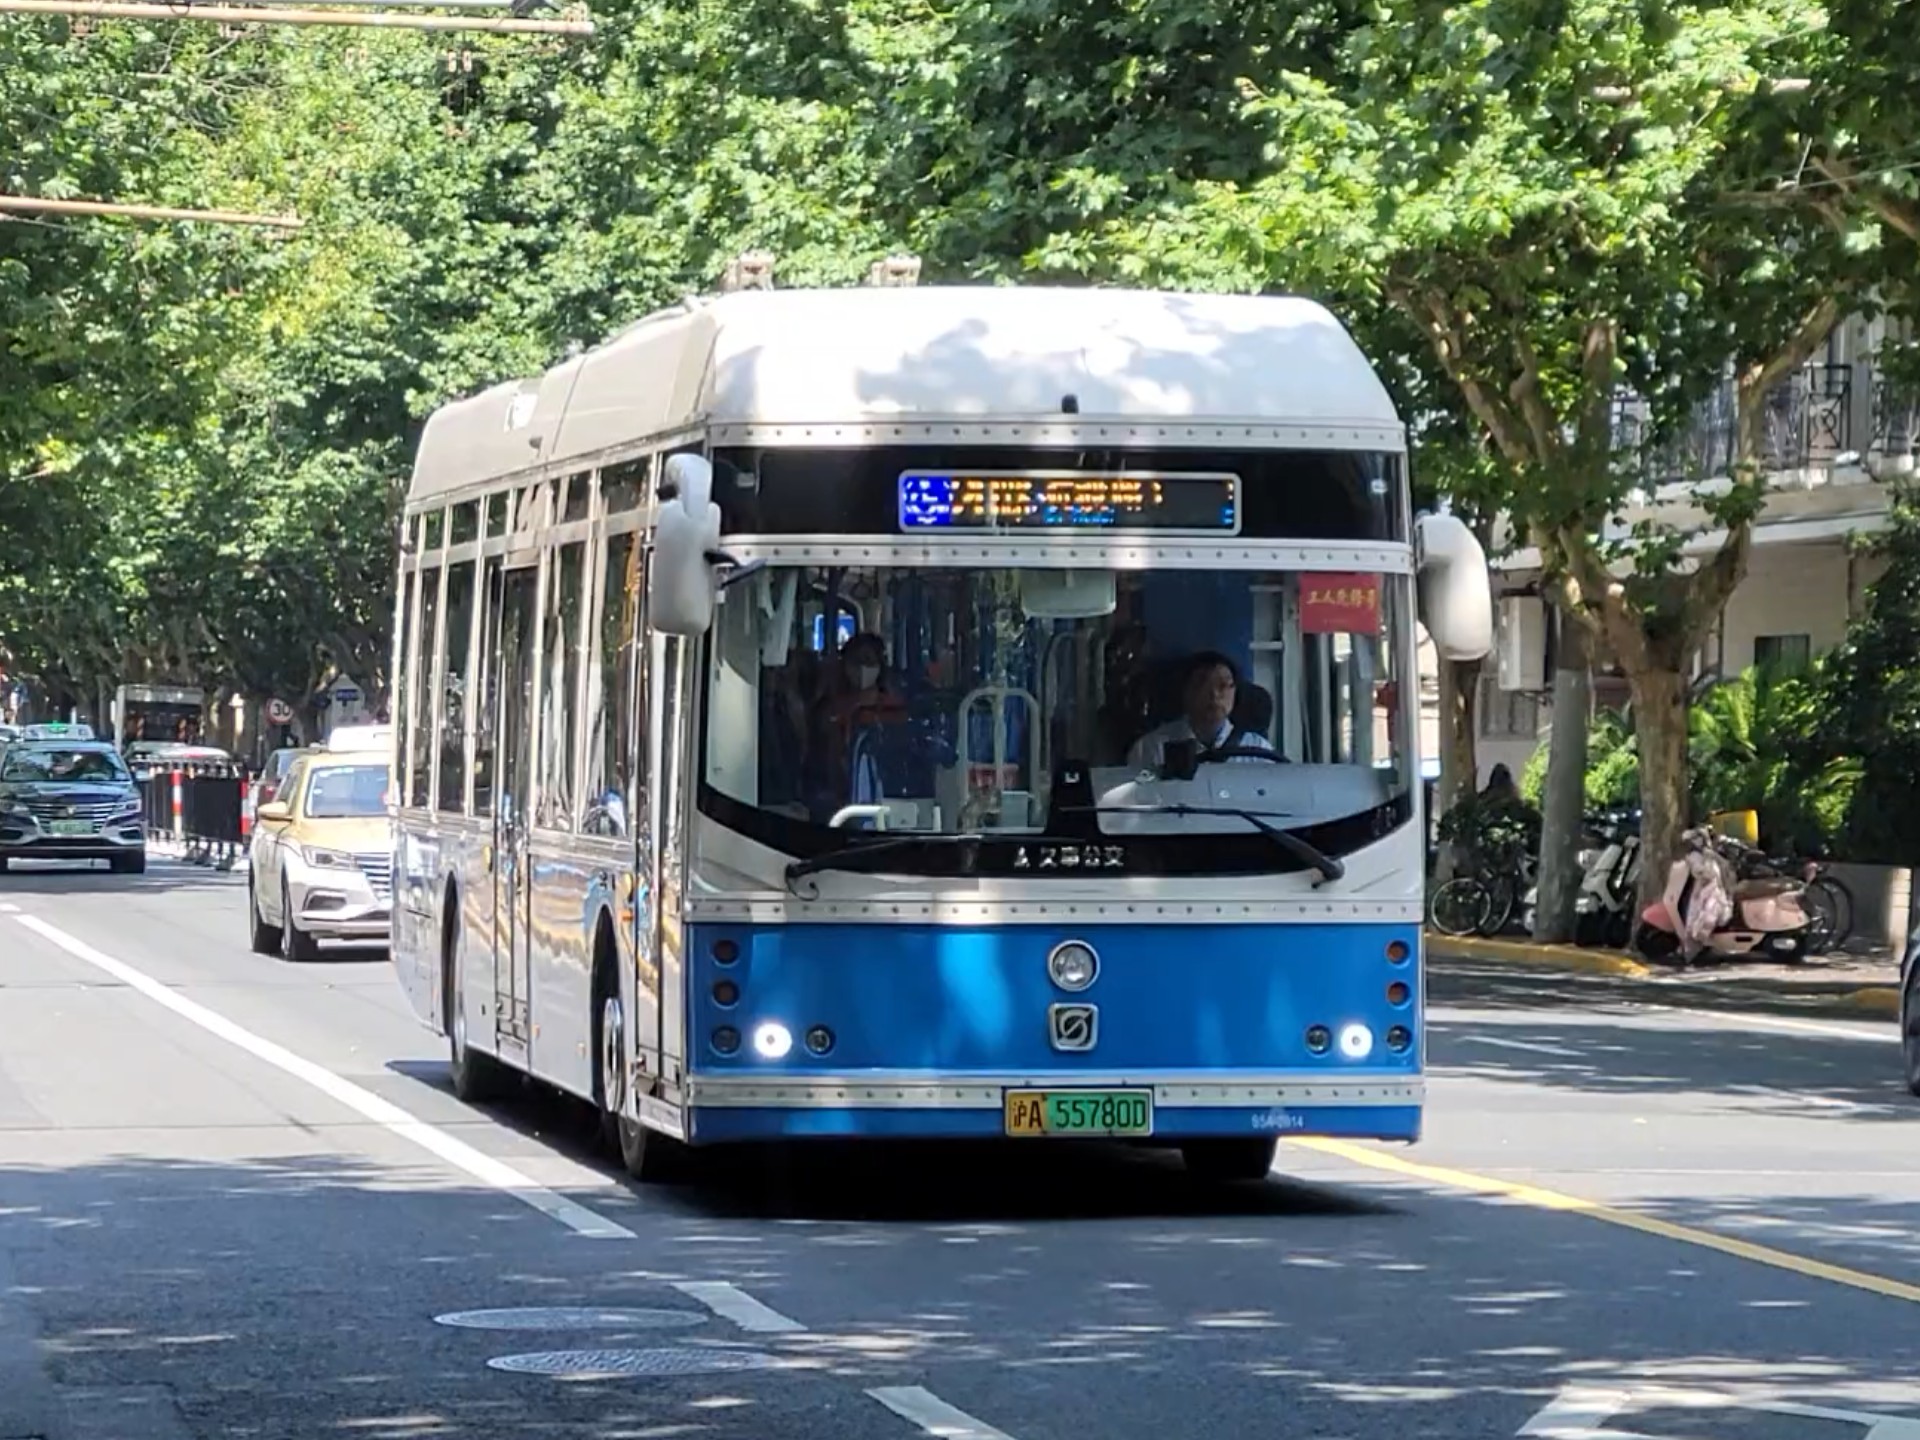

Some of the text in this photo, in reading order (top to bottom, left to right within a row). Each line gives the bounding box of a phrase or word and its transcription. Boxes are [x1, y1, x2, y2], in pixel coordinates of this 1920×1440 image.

[273, 702, 291, 716] 30
[1013, 1099, 1147, 1128] 沪A 55780D
